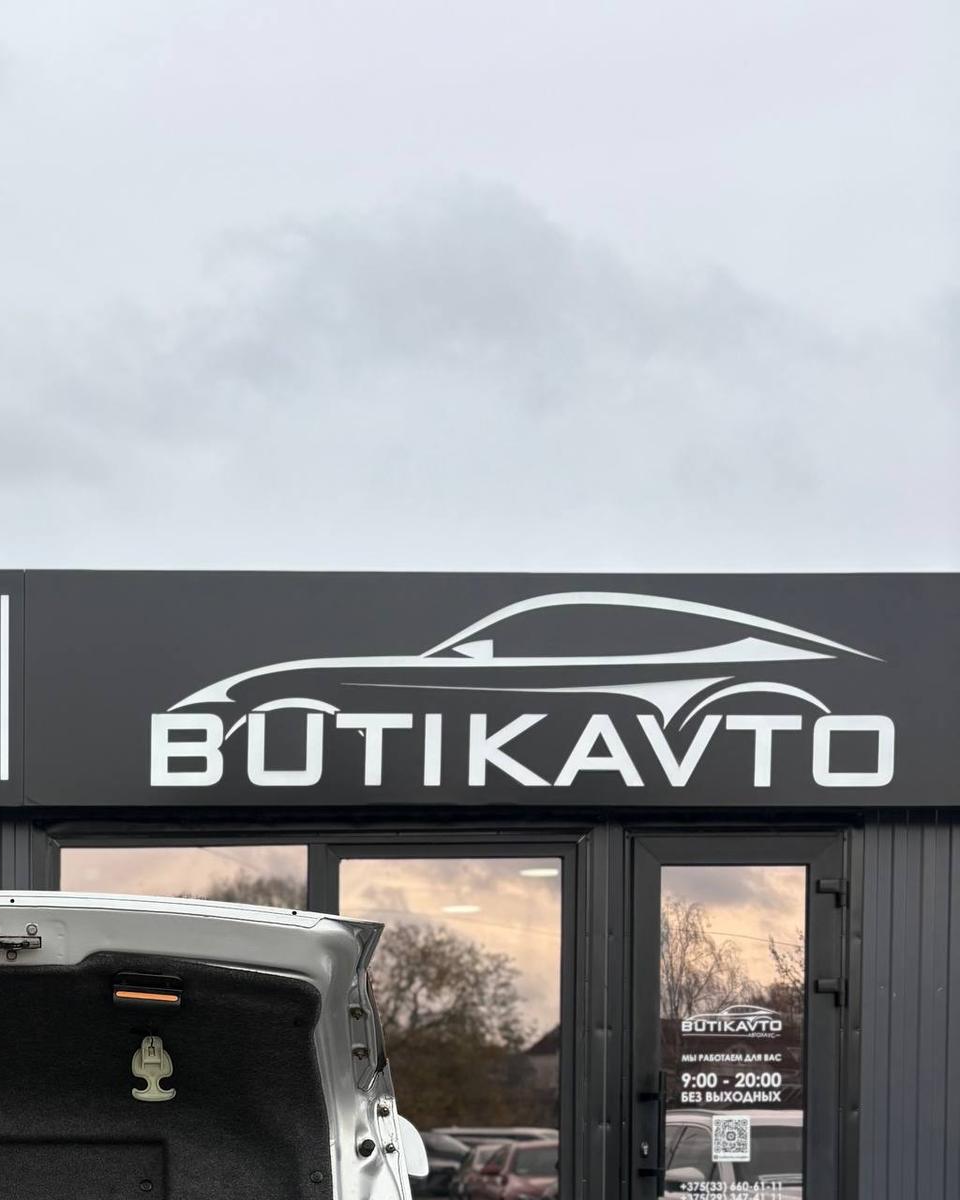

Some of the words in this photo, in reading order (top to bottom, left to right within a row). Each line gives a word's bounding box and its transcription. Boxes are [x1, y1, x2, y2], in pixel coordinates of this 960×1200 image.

[149, 712, 896, 789] BUTIKAVTO
[681, 1019, 783, 1032] BUTIKAVTO
[681, 1054, 697, 1062] МЫ
[698, 1054, 743, 1062] РАБОТАЕМ
[744, 1054, 762, 1063] ДЛЯ
[763, 1054, 782, 1062] ВАС
[681, 1072, 718, 1089] 9:00
[734, 1072, 782, 1088] 20:00
[681, 1091, 702, 1103] БЕЗ
[705, 1090, 781, 1104] ВЫХОДНЫХ
[680, 1181, 727, 1193] +375(33)
[729, 1181, 782, 1192] 660-61-11
